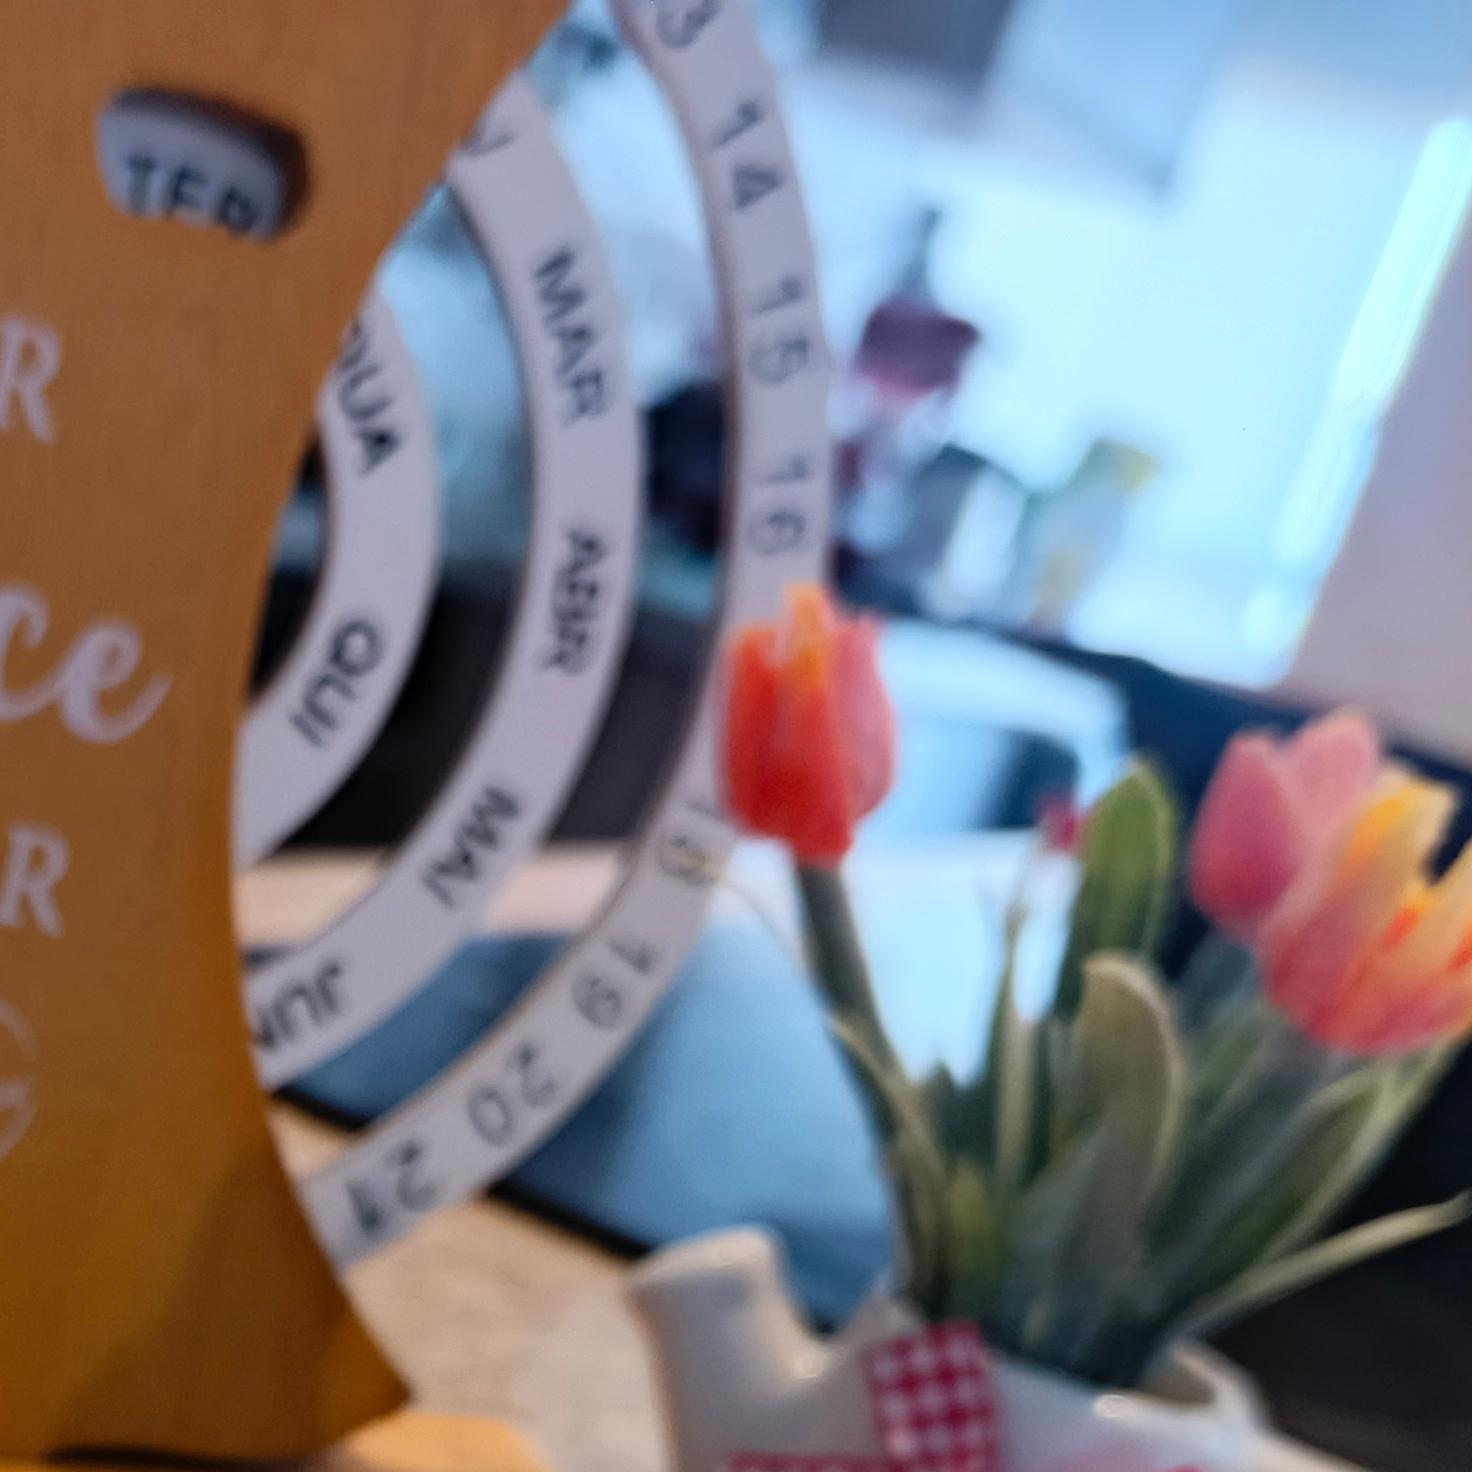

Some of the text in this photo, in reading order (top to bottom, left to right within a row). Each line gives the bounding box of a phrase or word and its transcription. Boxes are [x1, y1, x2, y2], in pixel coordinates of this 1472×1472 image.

[711, 99, 785, 212] 14
[534, 246, 610, 426] MAR
[745, 277, 811, 384] 15
[747, 456, 812, 556] 16
[288, 618, 383, 747] QUI
[421, 786, 521, 908] MAI
[570, 938, 656, 1032] 19
[466, 1043, 559, 1148] 20
[345, 1138, 439, 1236] 21
